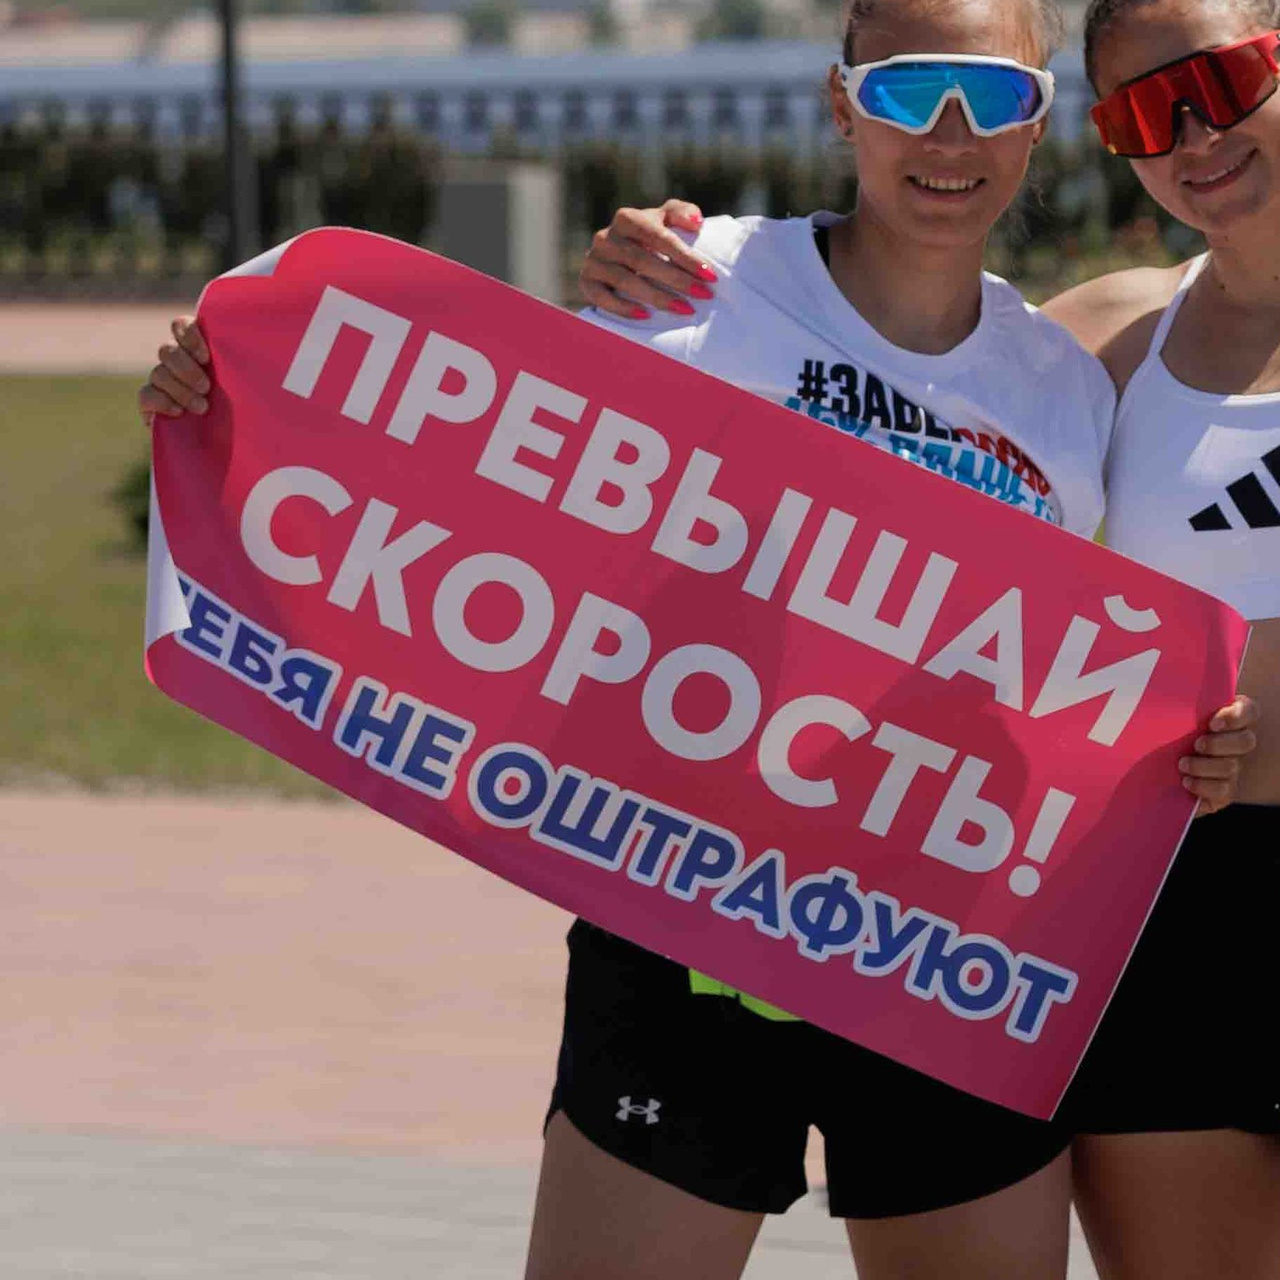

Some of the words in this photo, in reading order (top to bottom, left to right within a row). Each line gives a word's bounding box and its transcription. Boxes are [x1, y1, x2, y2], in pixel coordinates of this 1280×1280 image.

[239, 466, 1077, 897] СКОРОСТЬ!
[283, 287, 1161, 747] ПРЕВЫШАЙ
[340, 683, 468, 792] НЕ
[476, 750, 1073, 1037] ОШТРАФУЮТ
